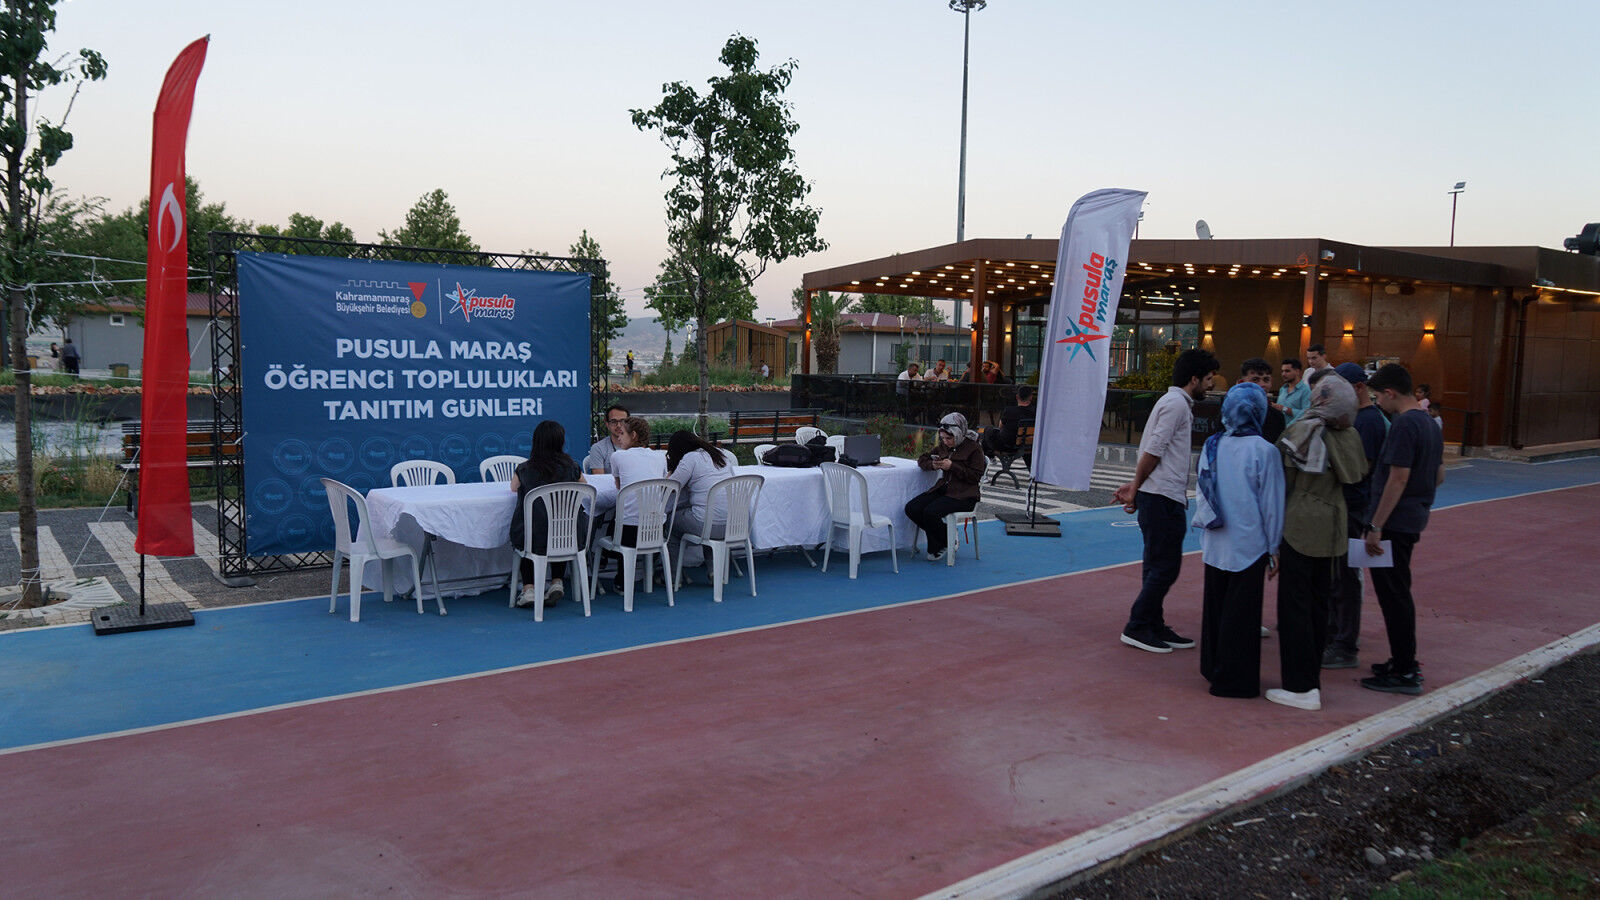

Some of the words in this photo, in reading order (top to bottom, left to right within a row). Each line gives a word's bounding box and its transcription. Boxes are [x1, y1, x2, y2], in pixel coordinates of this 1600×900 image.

[335, 291, 410, 304] Kahramanmaraş
[1078, 251, 1105, 332] pusula
[1096, 256, 1118, 323] maraş
[336, 302, 375, 314] Büyükşehir
[376, 304, 411, 315] Belediyesi
[469, 294, 516, 312] pusula
[473, 308, 516, 320] maraş
[336, 338, 443, 360] PUSULA
[450, 341, 532, 363] MARAŞ
[264, 363, 394, 390] ÖĞRENCİ
[402, 369, 578, 389] TOPLULUKLARI
[323, 400, 433, 421] TANITIM
[442, 398, 543, 418] GÜNLERİ
